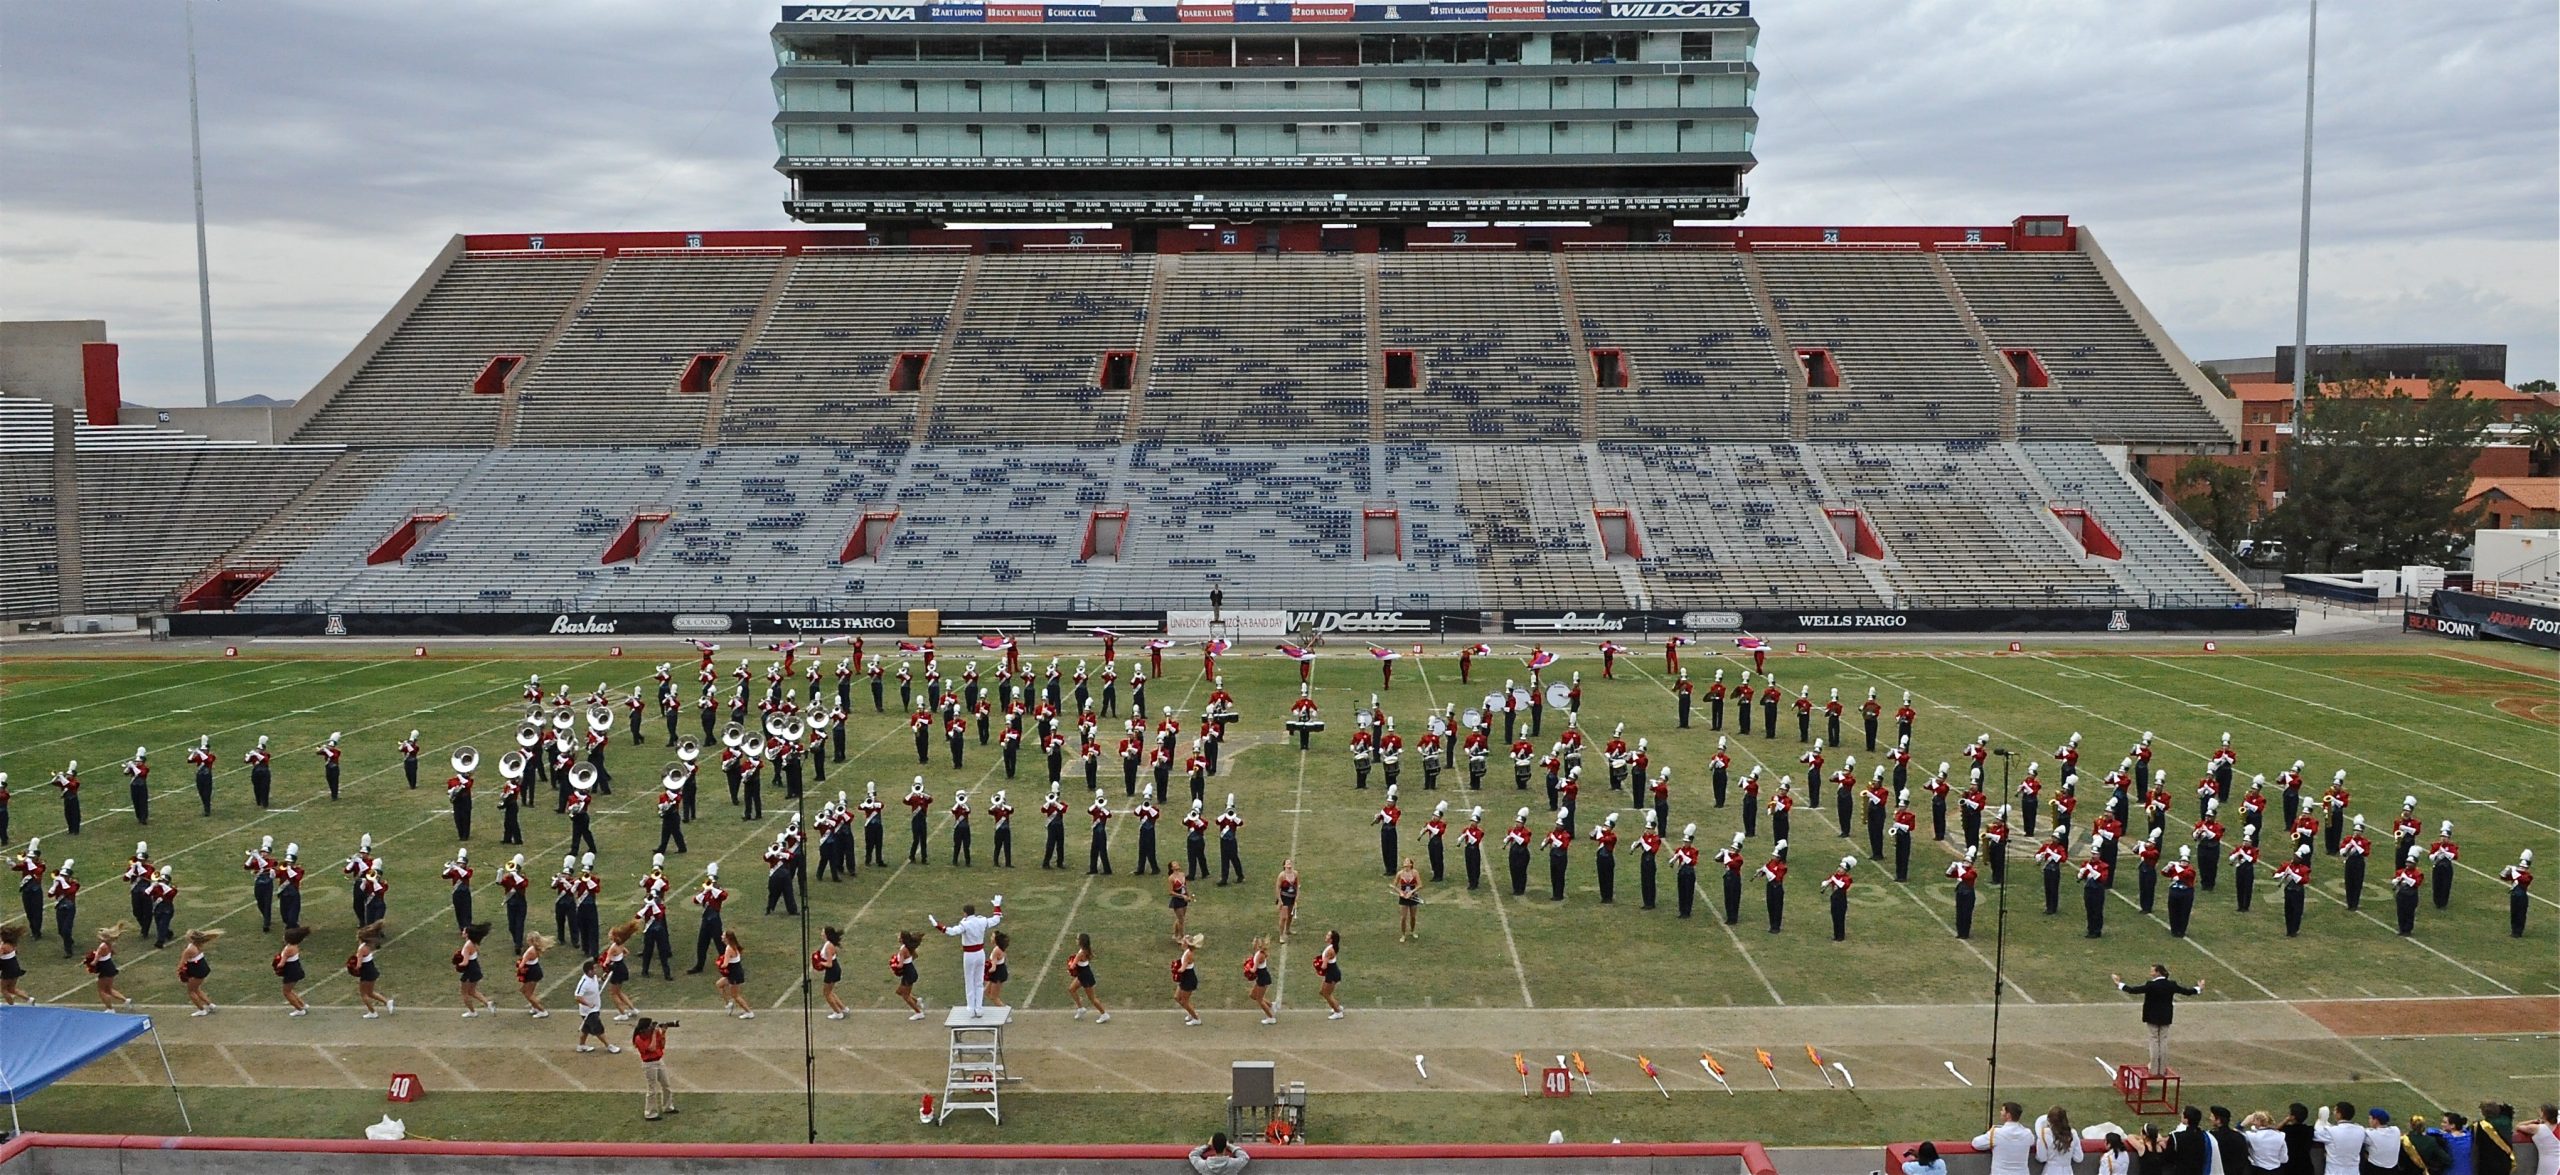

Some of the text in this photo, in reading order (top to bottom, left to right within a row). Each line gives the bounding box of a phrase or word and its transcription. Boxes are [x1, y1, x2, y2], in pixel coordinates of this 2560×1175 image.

[796, 7, 915, 21] ARIZONA
[932, 8, 940, 16] 22
[1048, 9, 1096, 17] 6 CHUCK CECIL
[1178, 9, 1183, 17] 4
[1488, 6, 1494, 14] 11
[1610, 3, 1742, 17] WILDCATS
[868, 237, 879, 246] 19
[1070, 236, 1083, 245] 20
[1223, 235, 1234, 244] 21
[1453, 234, 1466, 243] 22
[1657, 233, 1671, 242] 23
[1824, 233, 1838, 242] 24
[1967, 234, 1980, 243] 25
[531, 241, 541, 250] 17
[689, 238, 700, 247] 18
[159, 413, 169, 421] 16
[549, 614, 617, 633] Bashas'
[696, 617, 726, 625] CASINOS
[788, 617, 895, 629] WELLS FARGO
[1170, 619, 1206, 628] UNIVERSITY
[1249, 618, 1268, 628] BAND
[1270, 618, 1283, 628] DAY
[1705, 616, 1737, 625] CASINOS
[1799, 616, 1906, 627] WELLS FARGO
[973, 1075, 990, 1092] 50
[1547, 1072, 1566, 1093] 40
[391, 1077, 410, 1098] 40
